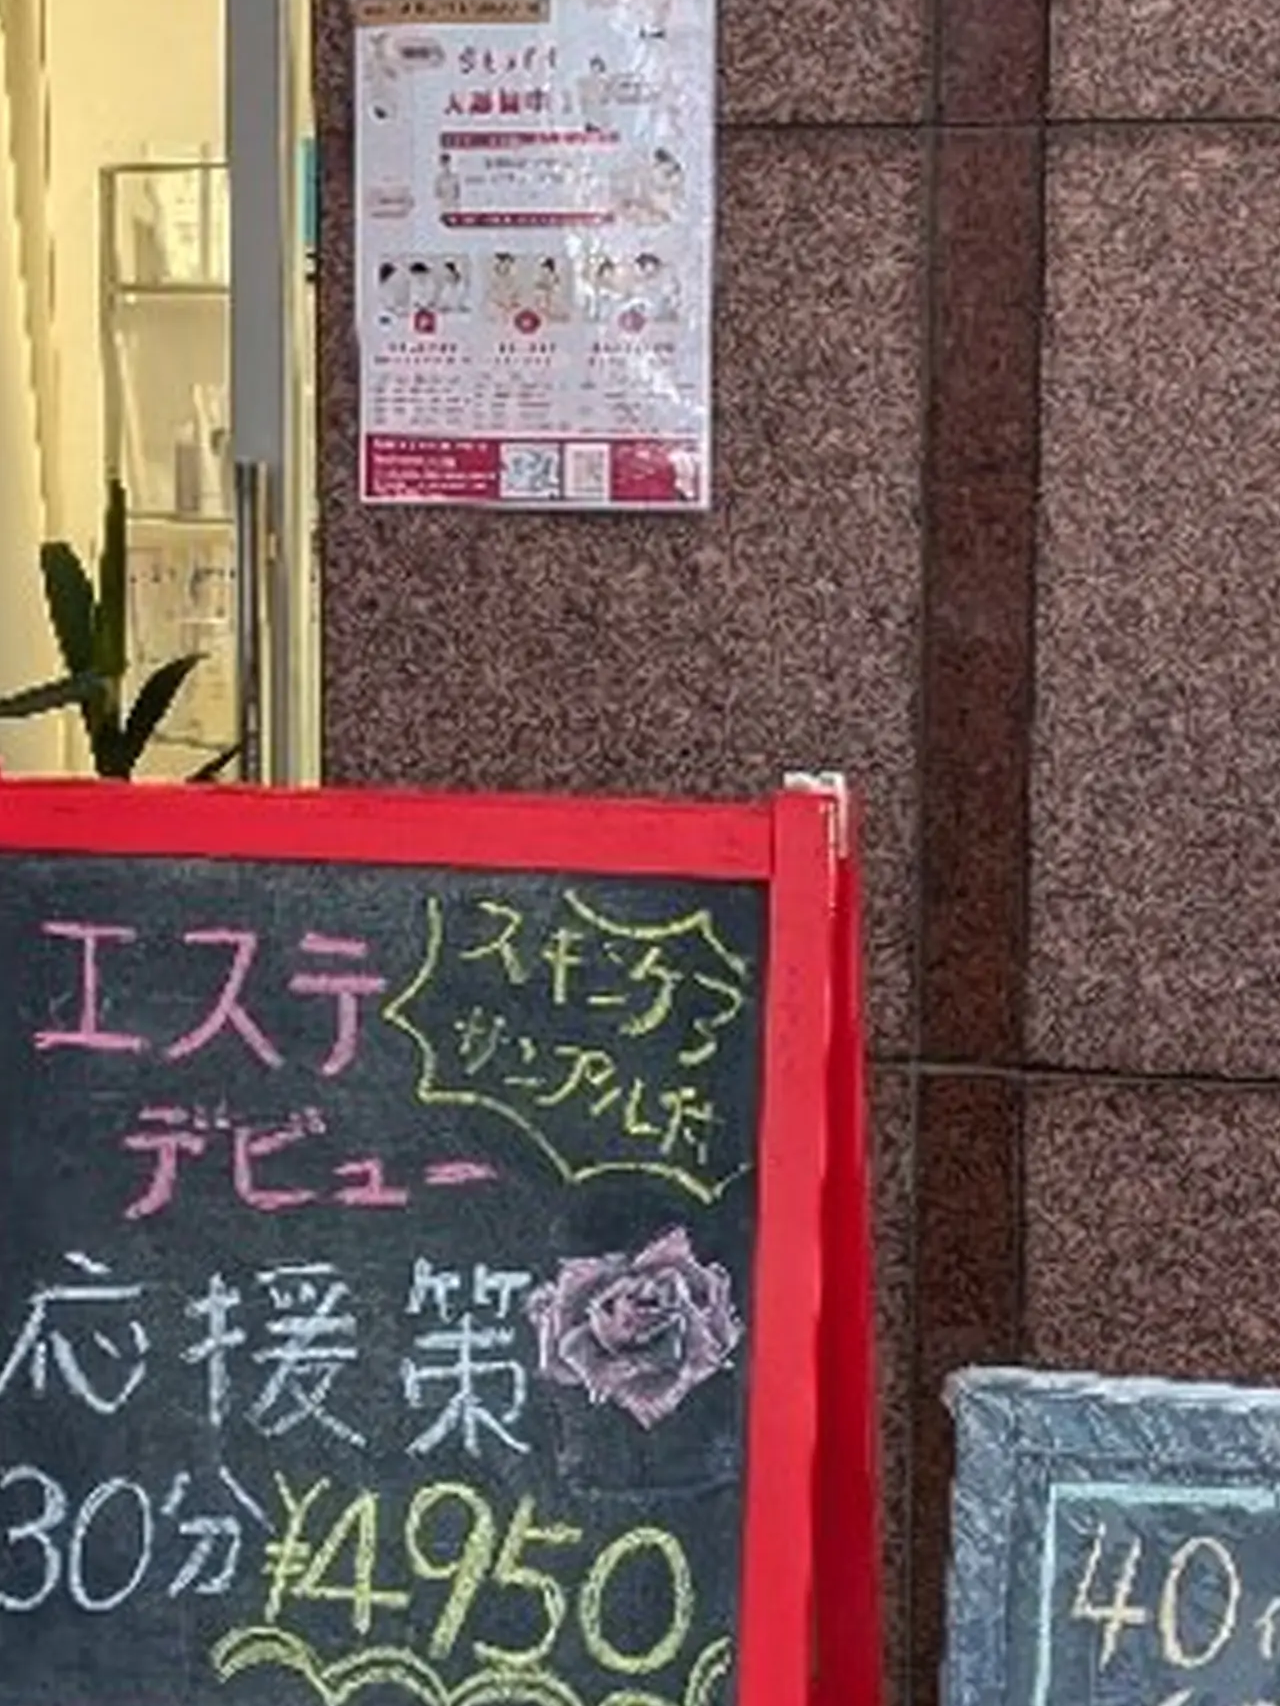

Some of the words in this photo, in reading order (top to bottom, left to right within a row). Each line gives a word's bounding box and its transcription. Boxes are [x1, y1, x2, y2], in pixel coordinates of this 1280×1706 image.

[34, 920, 387, 1076] エステ
[124, 1104, 498, 1222] デビュー
